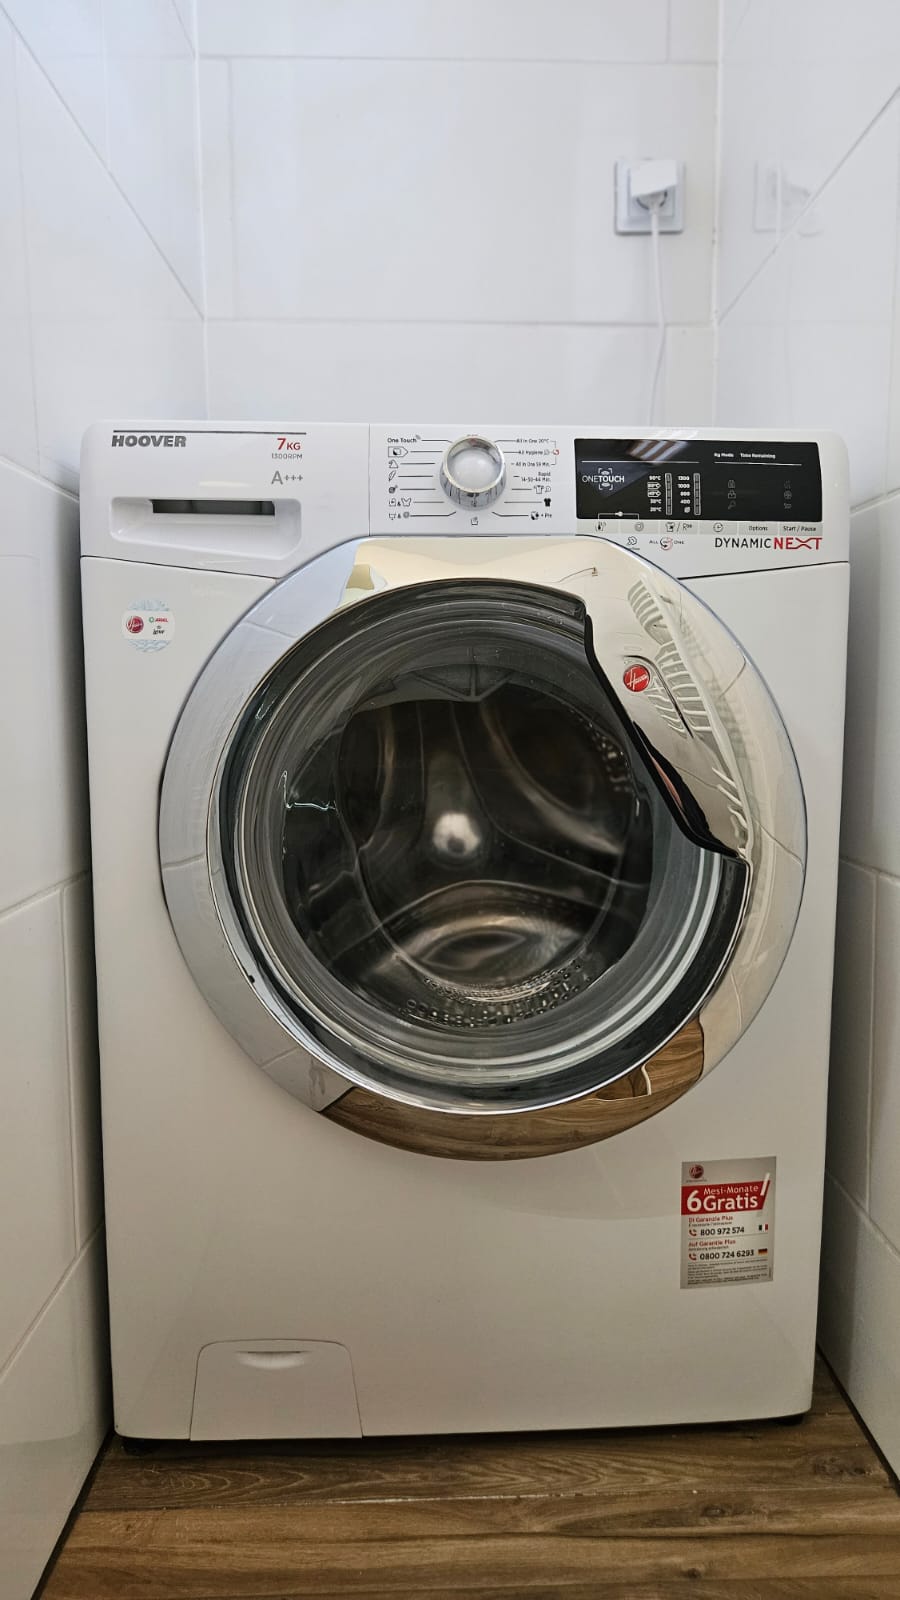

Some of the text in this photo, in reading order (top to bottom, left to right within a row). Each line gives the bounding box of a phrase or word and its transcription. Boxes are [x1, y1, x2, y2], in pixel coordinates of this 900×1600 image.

[111, 434, 187, 448] HOOVER
[276, 437, 301, 451] 7KG
[271, 452, 303, 460] 1300RPM
[270, 470, 304, 485] A+++
[714, 537, 823, 550] DYNAMIC NEXT
[703, 1185, 760, 1196] Mesi-Monate
[686, 1189, 702, 1213] 6
[700, 1226, 745, 1237] 800 972 574
[699, 1252, 720, 1260] 0800
[721, 1251, 735, 1259] 724
[736, 1249, 755, 1258] 6293
